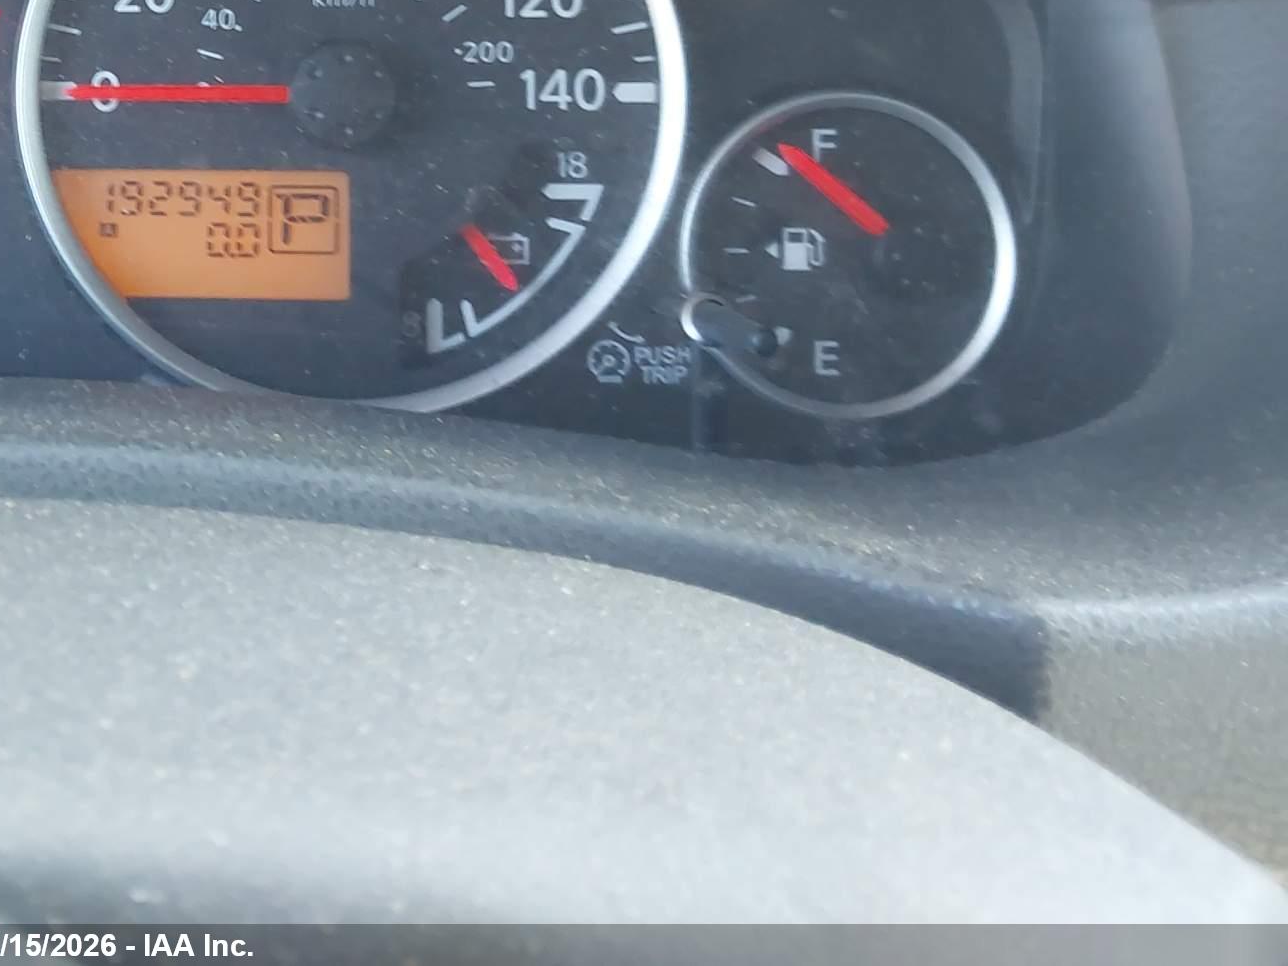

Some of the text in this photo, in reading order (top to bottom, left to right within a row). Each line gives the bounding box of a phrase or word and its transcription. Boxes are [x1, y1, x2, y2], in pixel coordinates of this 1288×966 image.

[201, 9, 235, 31] 40
[463, 41, 514, 63] 200
[90, 71, 121, 112] 0
[521, 69, 605, 112] 140
[812, 128, 838, 164] F
[556, 152, 587, 178] 18
[108, 181, 260, 217] 192949
[276, 192, 330, 245] P
[634, 346, 691, 364] PUSH
[814, 340, 840, 376] E
[640, 365, 688, 384] TRIP
